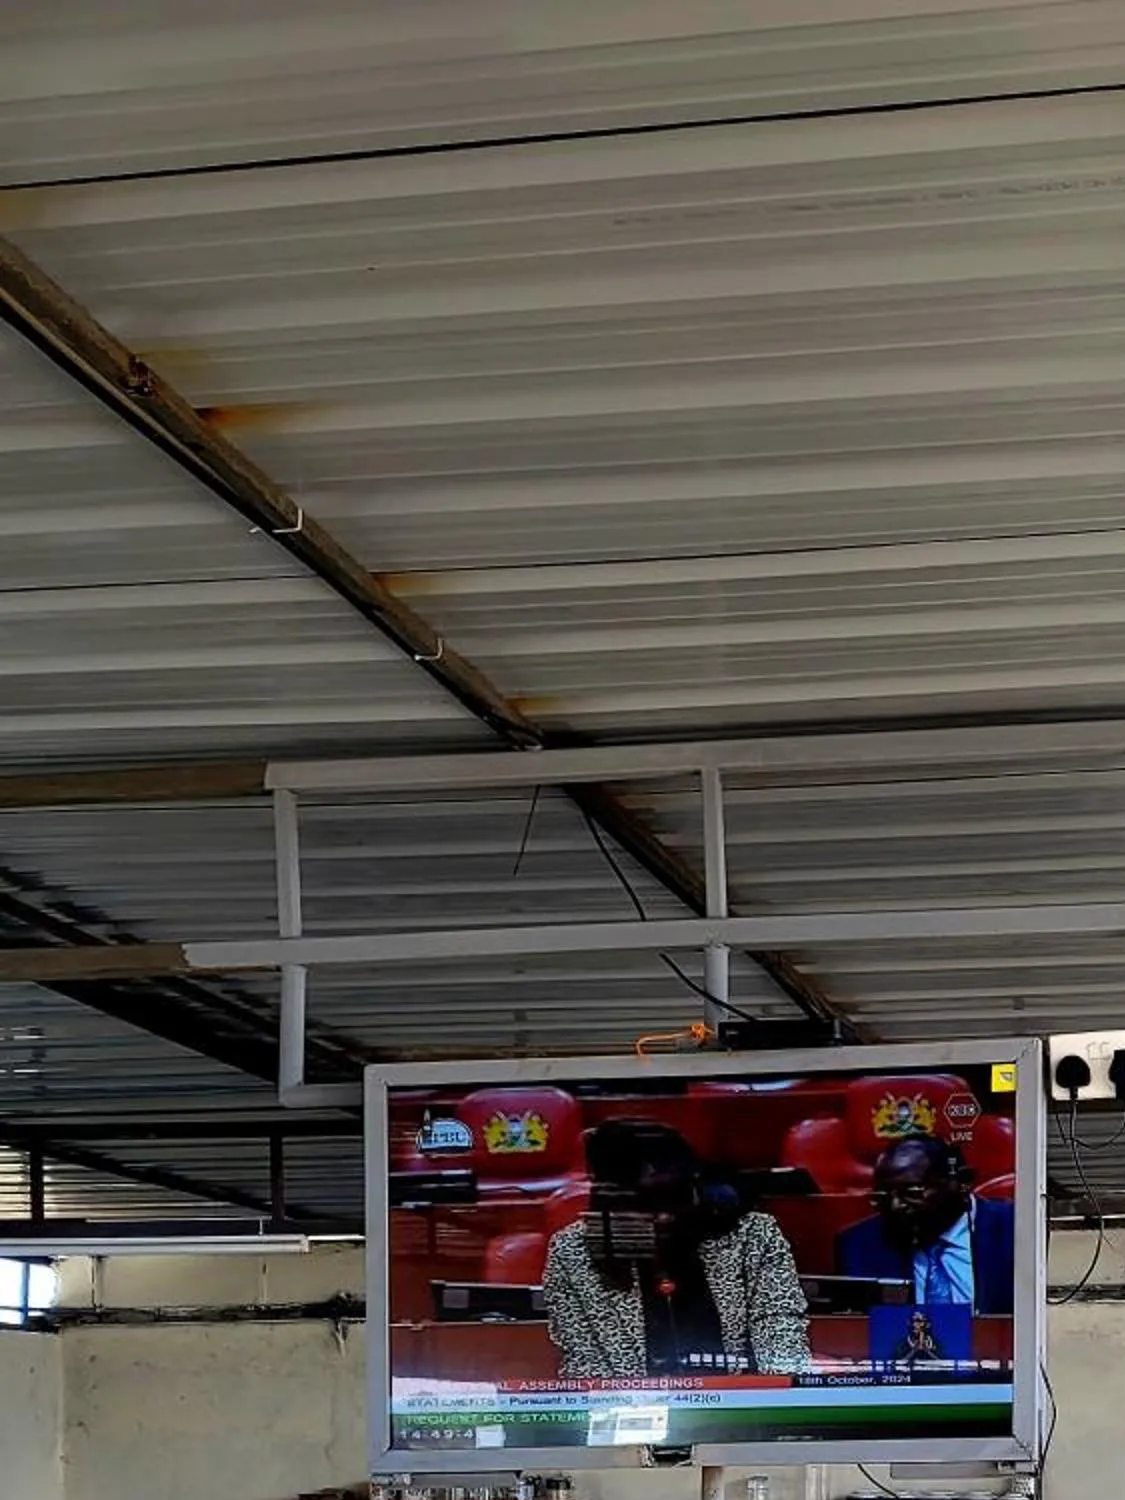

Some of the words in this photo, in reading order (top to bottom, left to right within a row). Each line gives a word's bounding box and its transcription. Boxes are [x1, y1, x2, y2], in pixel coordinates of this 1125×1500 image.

[519, 1378, 595, 1391] ASSEMBLY
[601, 1377, 704, 1390] PROCEEDINGS
[882, 1374, 912, 1385] 2024
[509, 1396, 561, 1406] Pursuant
[565, 1396, 577, 1405] to
[483, 1414, 515, 1423] FOR
